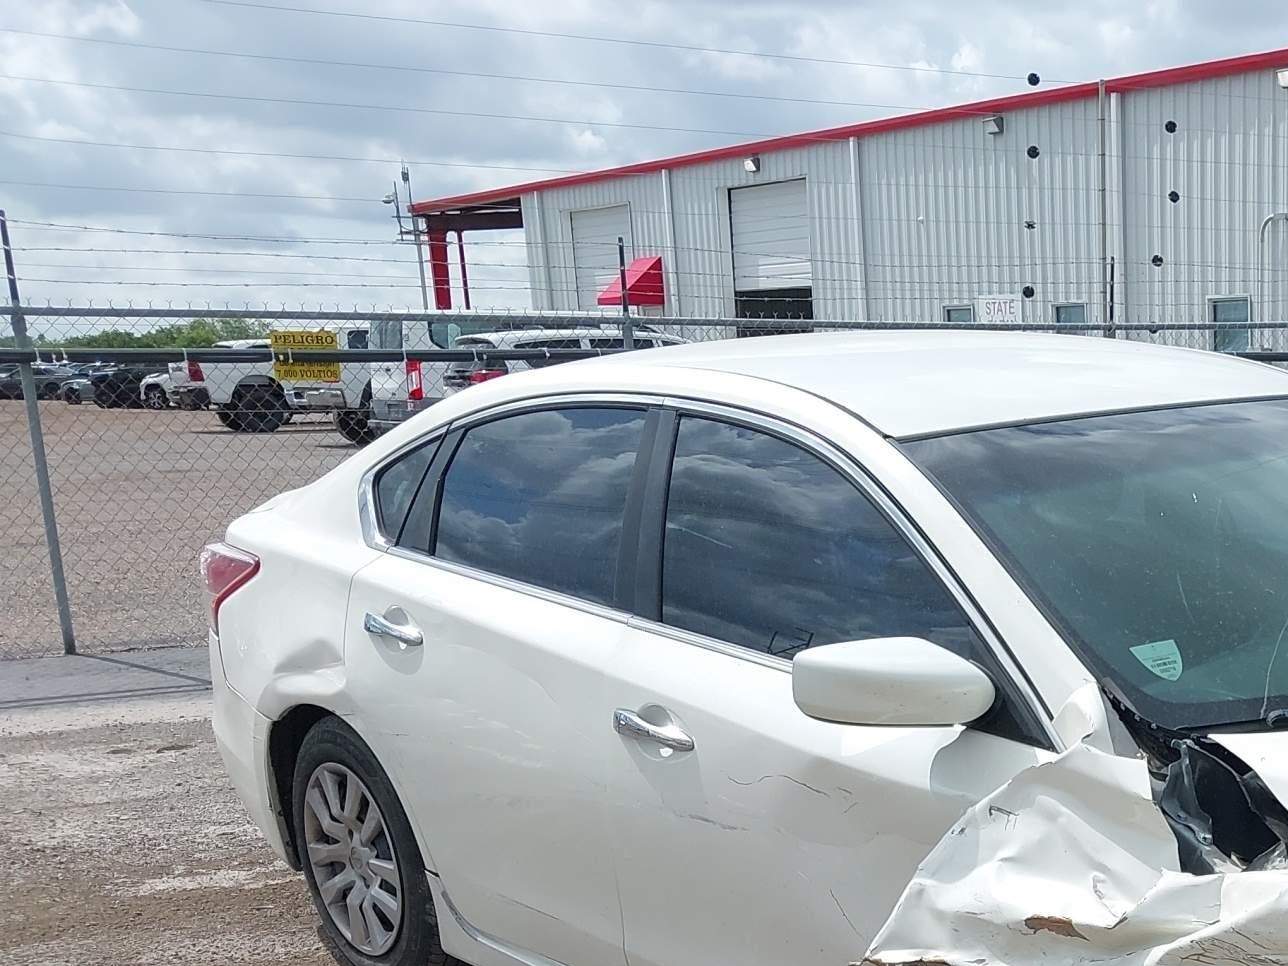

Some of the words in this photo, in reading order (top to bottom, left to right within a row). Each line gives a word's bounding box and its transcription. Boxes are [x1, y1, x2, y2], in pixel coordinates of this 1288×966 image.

[985, 301, 1015, 315] STATE
[273, 334, 334, 345] PELIGRO
[299, 369, 338, 379] VOLTIOS
